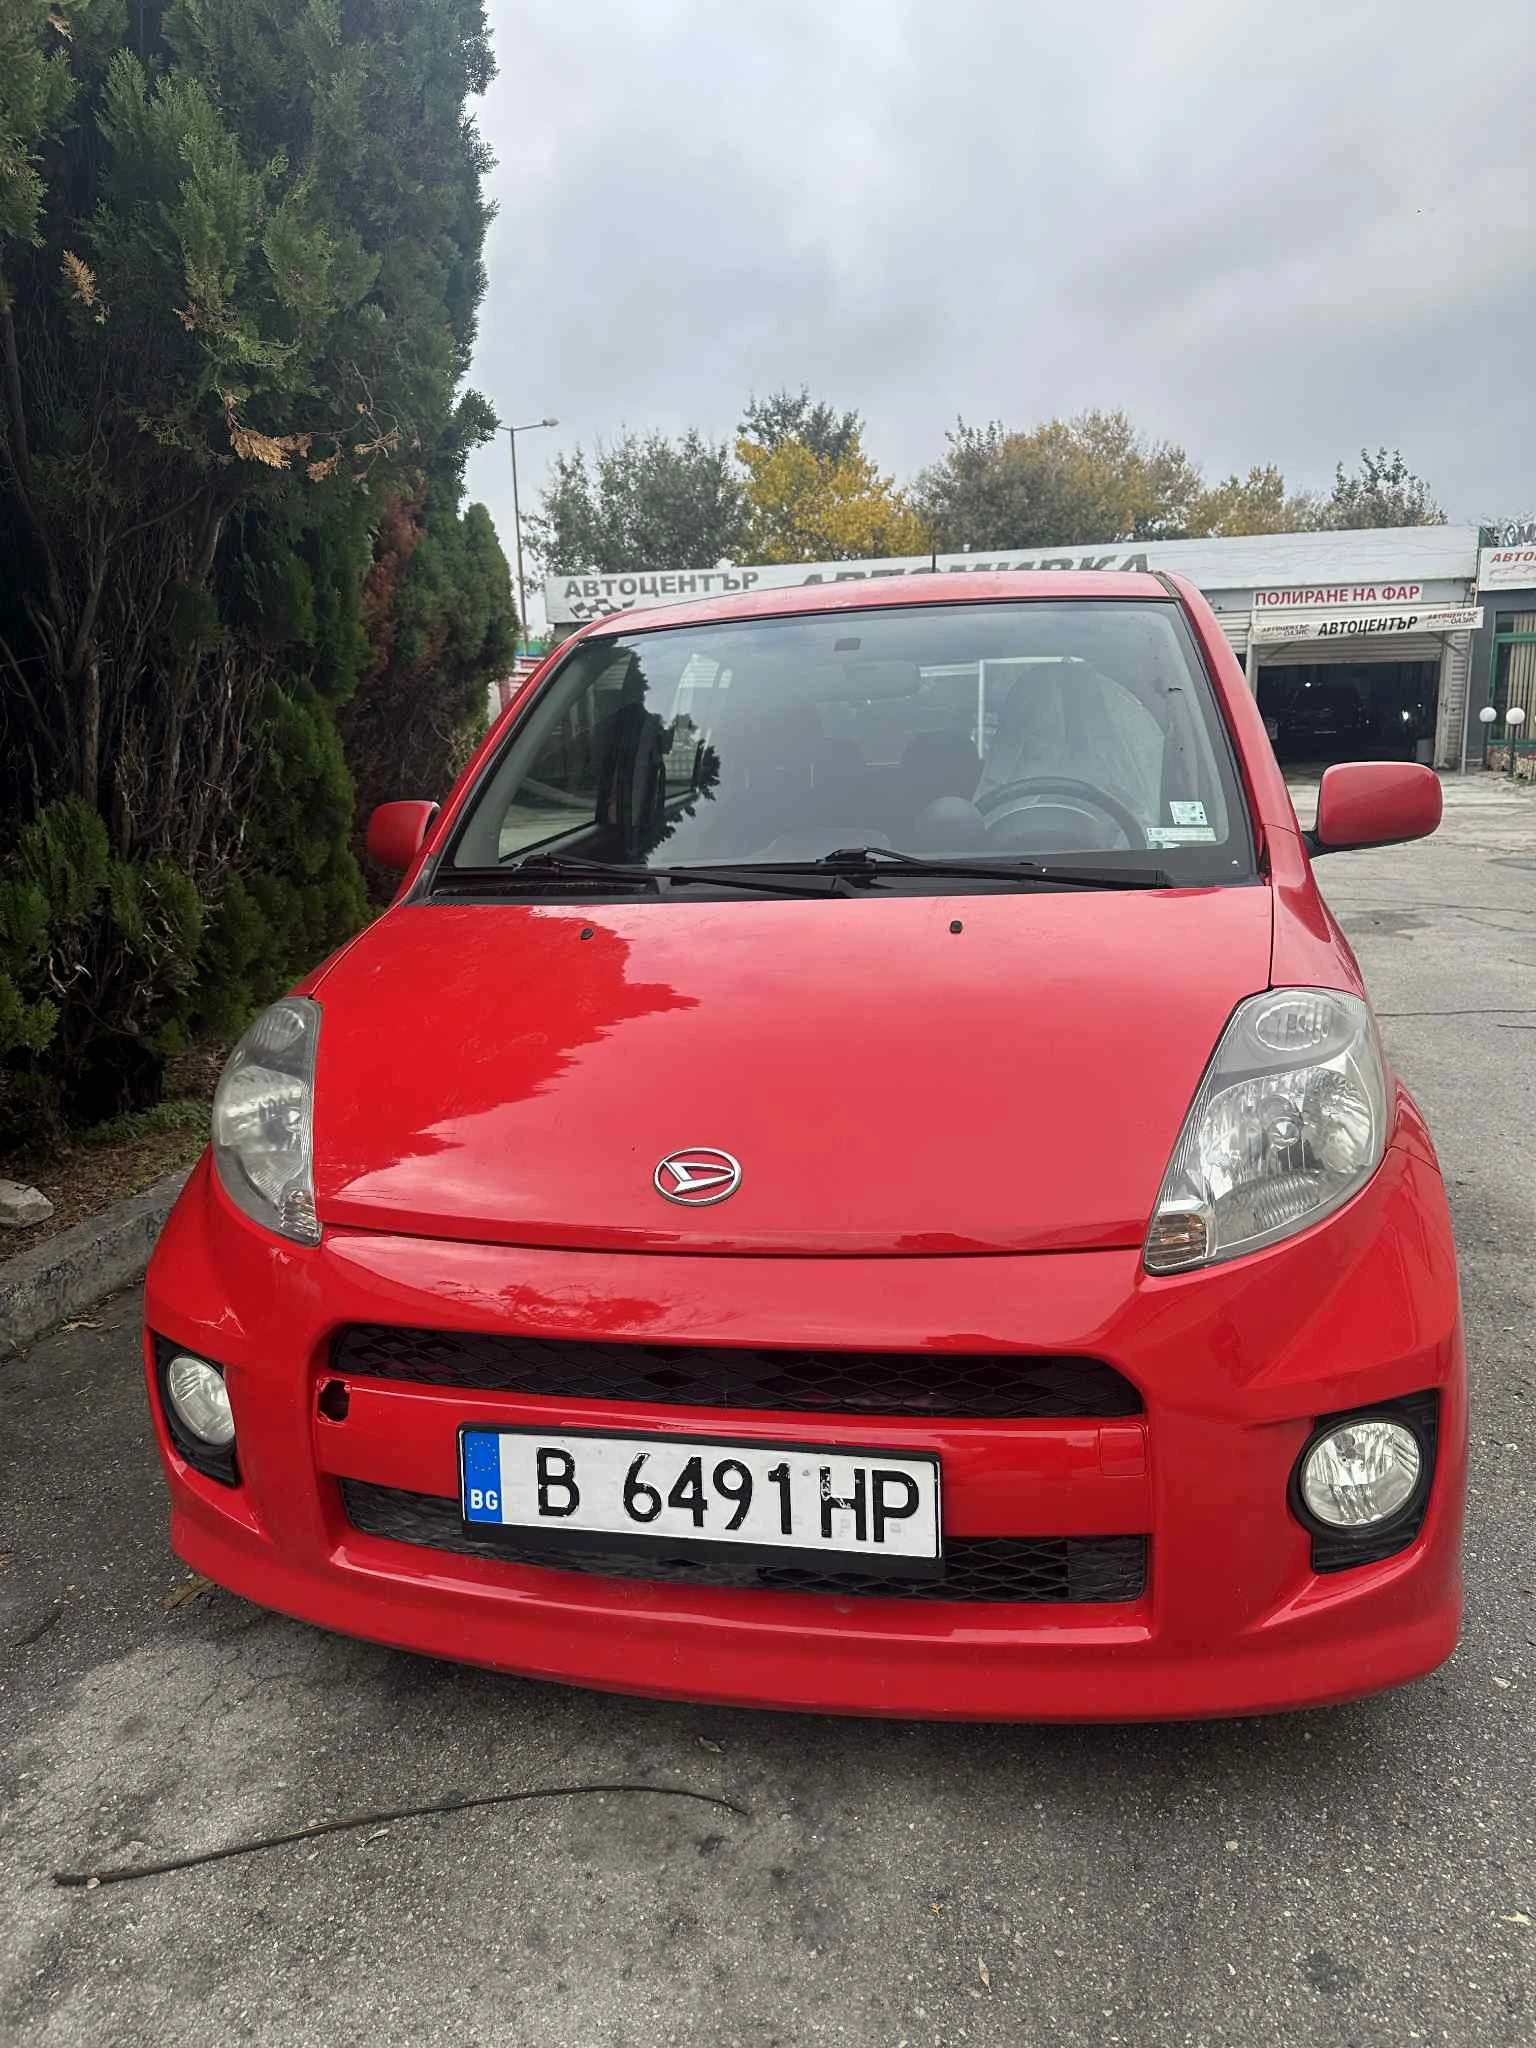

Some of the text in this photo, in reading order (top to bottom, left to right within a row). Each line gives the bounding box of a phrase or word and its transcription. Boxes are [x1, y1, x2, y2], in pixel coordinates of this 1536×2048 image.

[1489, 551, 1536, 563] АВТО
[564, 571, 759, 598] АВТОЦЕНТЪР
[1255, 585, 1420, 606] ПОЛИРАНЕ НА ФАР
[1318, 616, 1418, 636] АВТОЦЕНТЪР
[470, 1489, 499, 1511] BG
[536, 1447, 920, 1543] B 6491 HP
